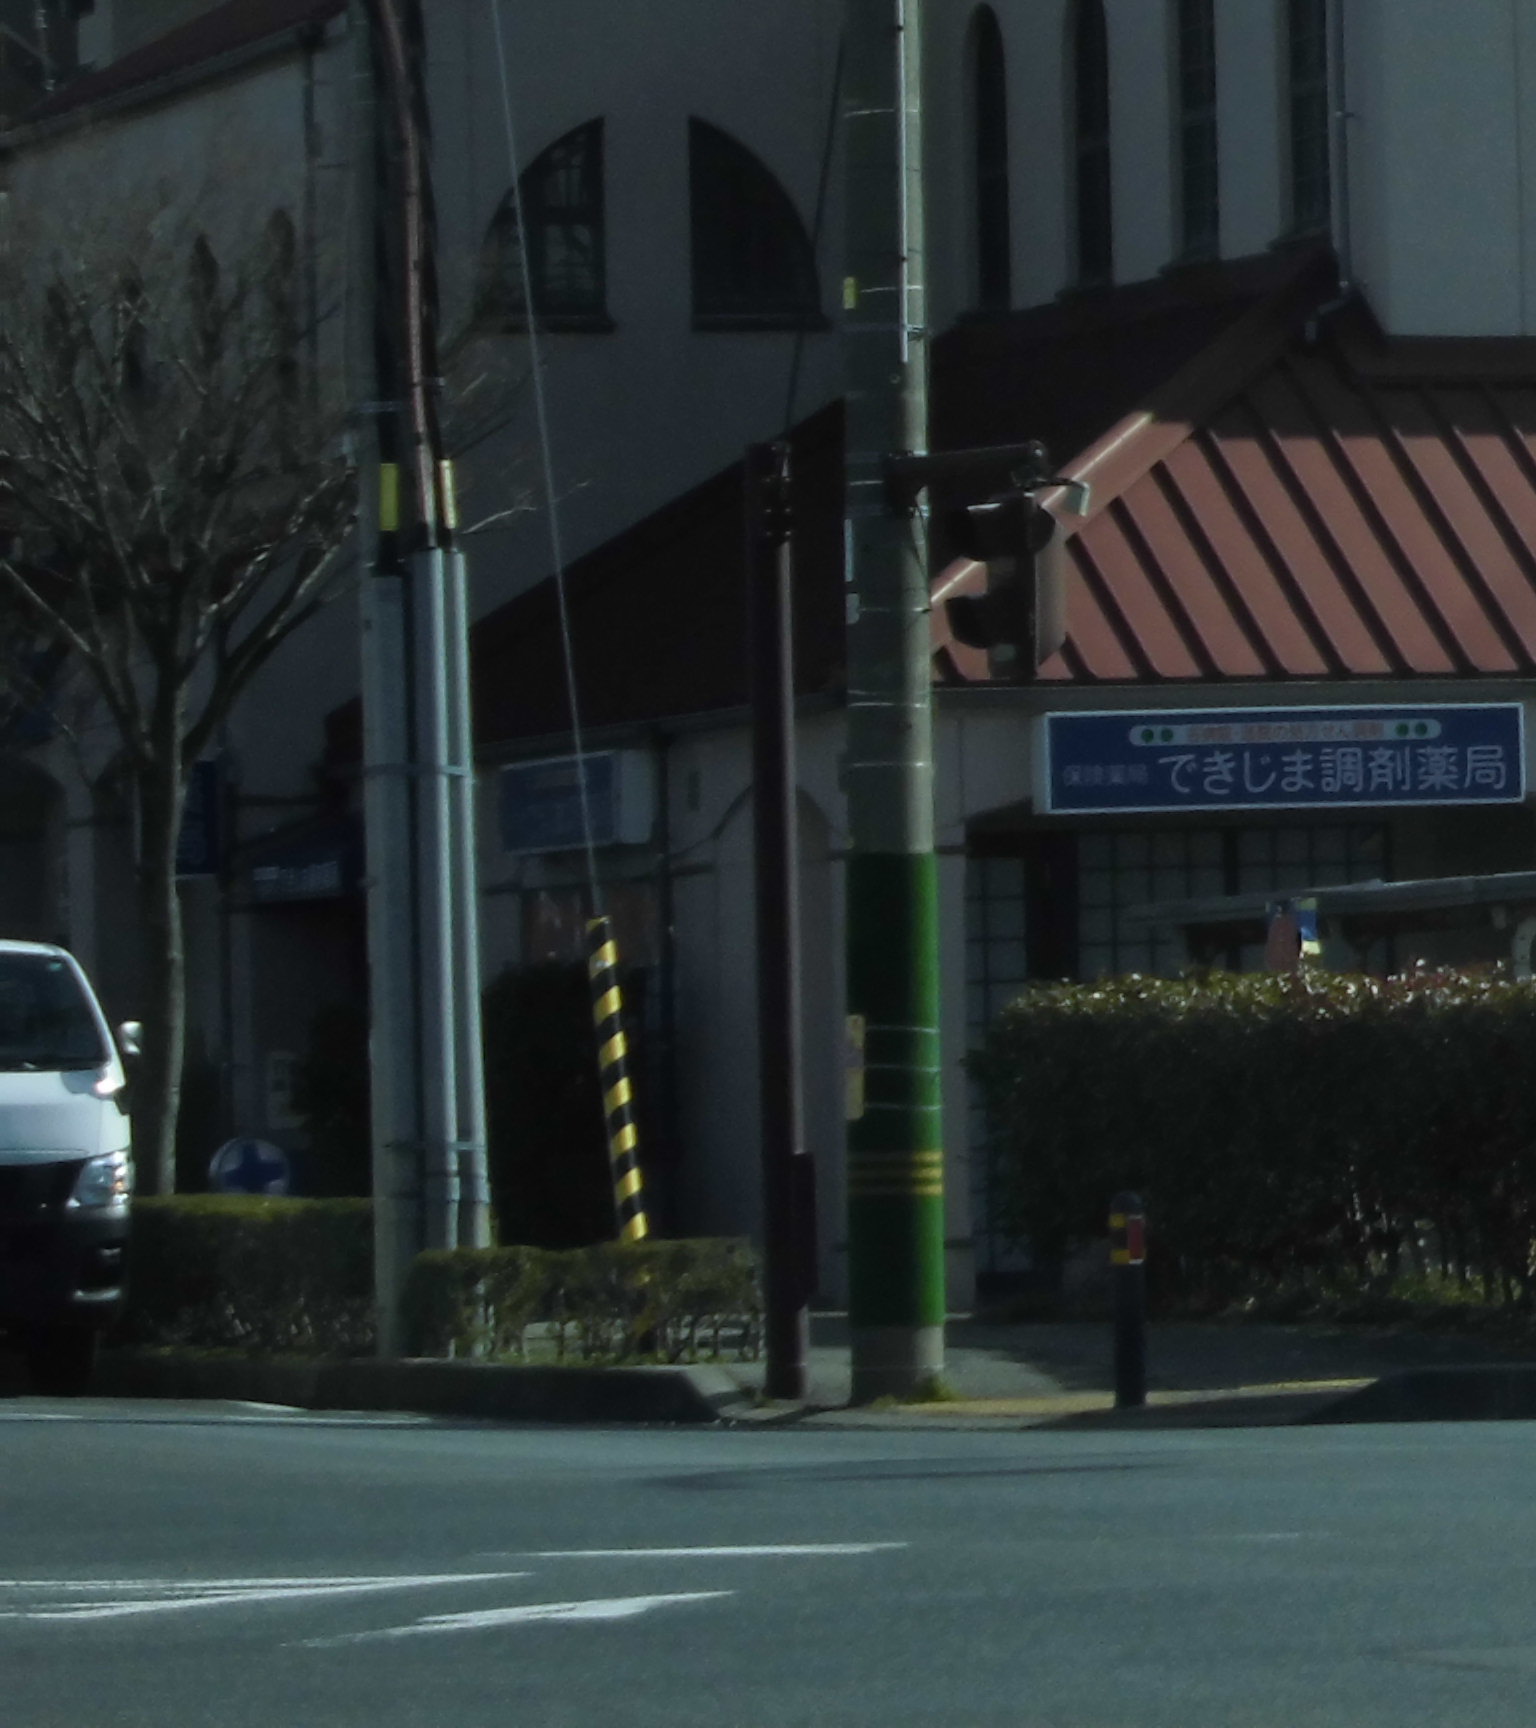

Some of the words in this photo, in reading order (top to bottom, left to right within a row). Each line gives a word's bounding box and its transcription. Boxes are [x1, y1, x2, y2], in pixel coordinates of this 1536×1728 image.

[1158, 744, 1507, 795] できじま調剤薬局
